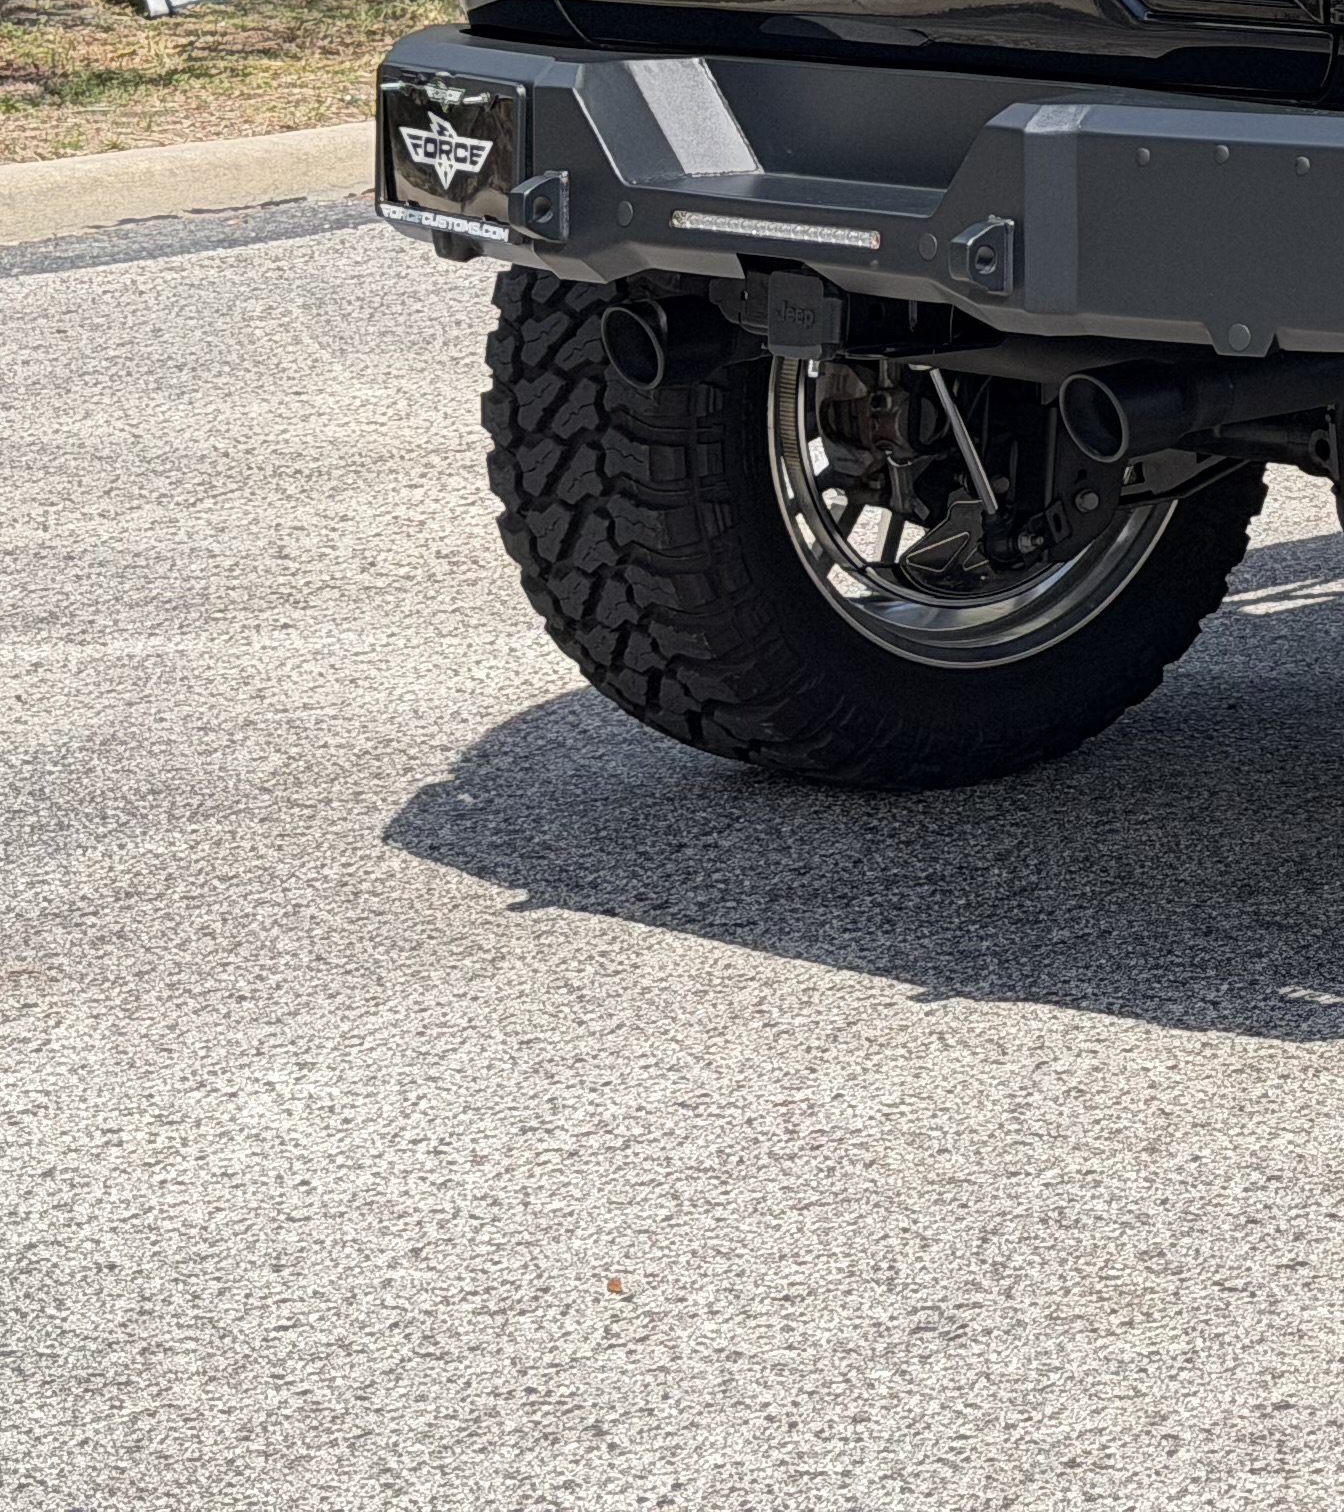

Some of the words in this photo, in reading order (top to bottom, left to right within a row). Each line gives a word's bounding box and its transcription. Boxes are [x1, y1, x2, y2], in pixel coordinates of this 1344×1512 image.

[404, 131, 488, 169] FORCE
[380, 202, 510, 243] FORCECUSTOMS.COM
[776, 299, 816, 330] Jeep
